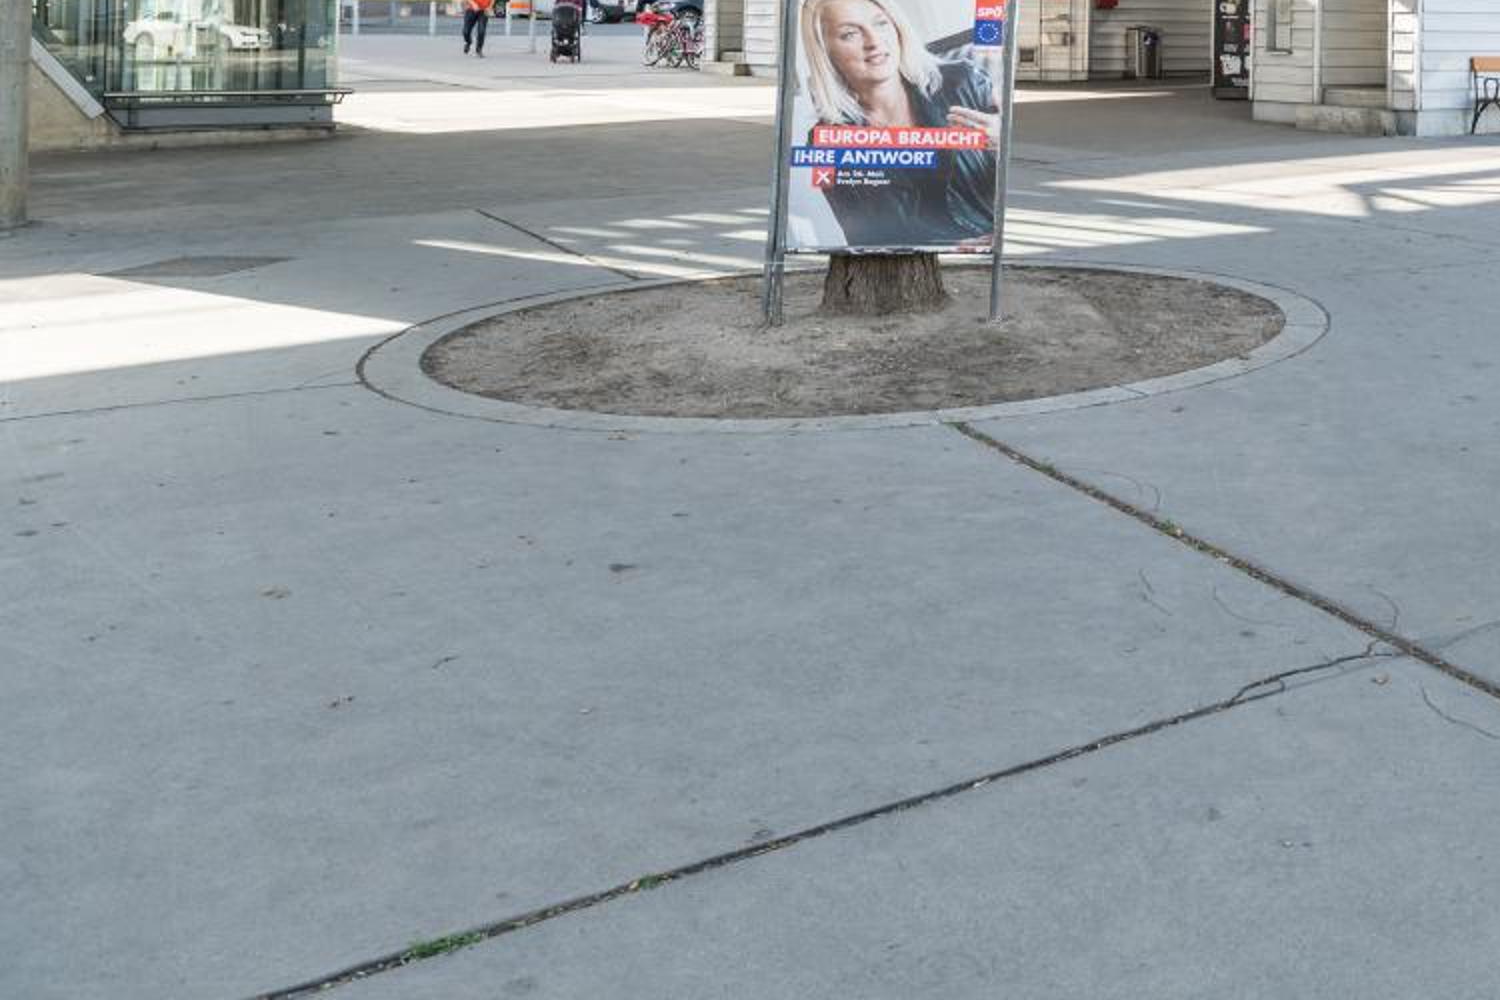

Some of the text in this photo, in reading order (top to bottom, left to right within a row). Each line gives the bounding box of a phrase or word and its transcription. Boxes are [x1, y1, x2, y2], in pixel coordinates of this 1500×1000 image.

[977, 5, 1003, 18] SPÖ
[818, 129, 980, 146] EUROPA BRAUCHT
[794, 149, 935, 166] IHRE ANTWORT
